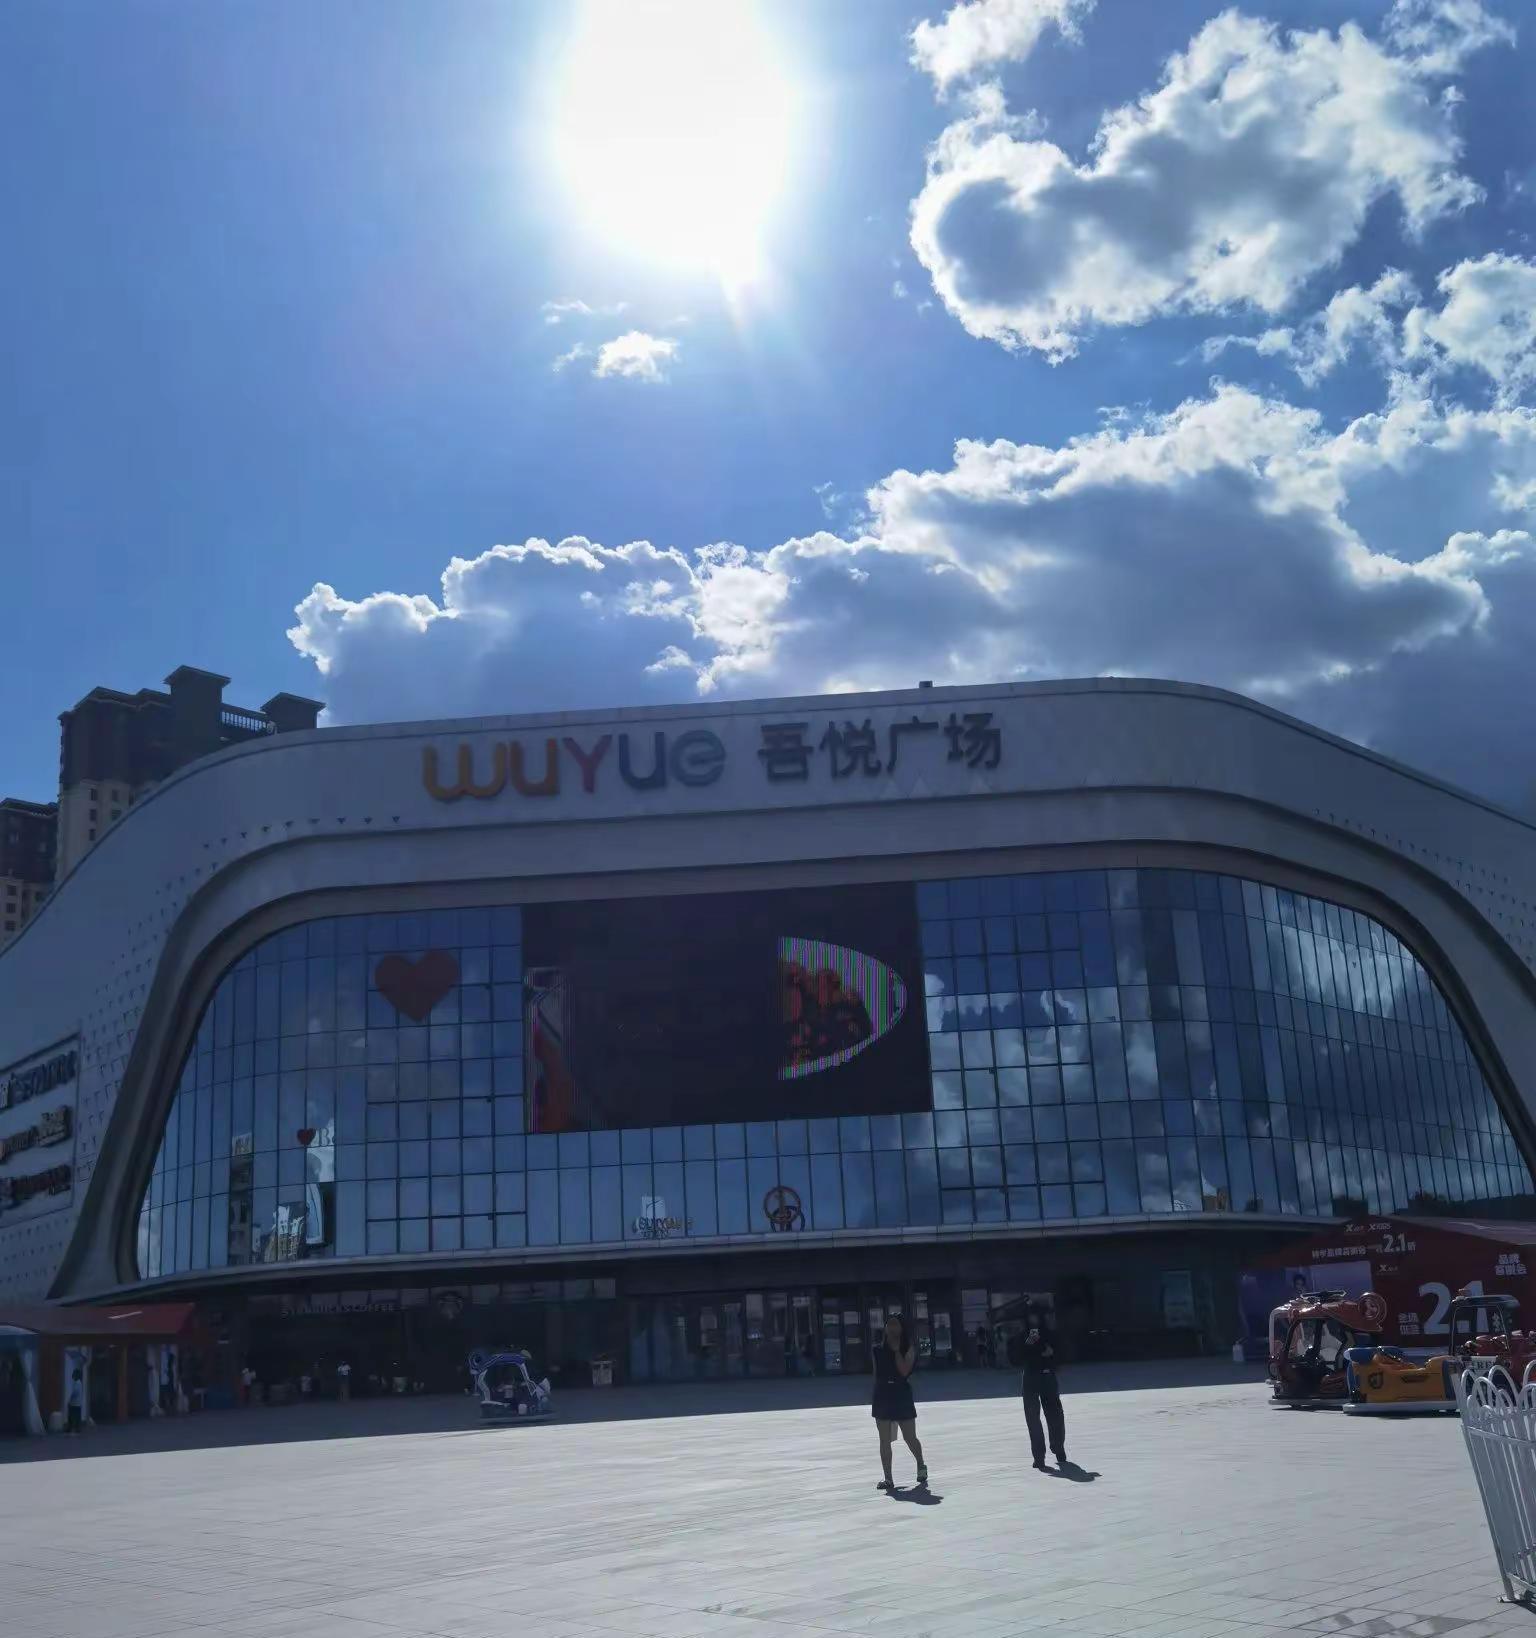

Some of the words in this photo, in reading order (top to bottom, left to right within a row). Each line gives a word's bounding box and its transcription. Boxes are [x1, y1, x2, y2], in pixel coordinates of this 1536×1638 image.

[757, 712, 1002, 782] 吾悦广场
[1418, 1280, 1490, 1335] 2.1
